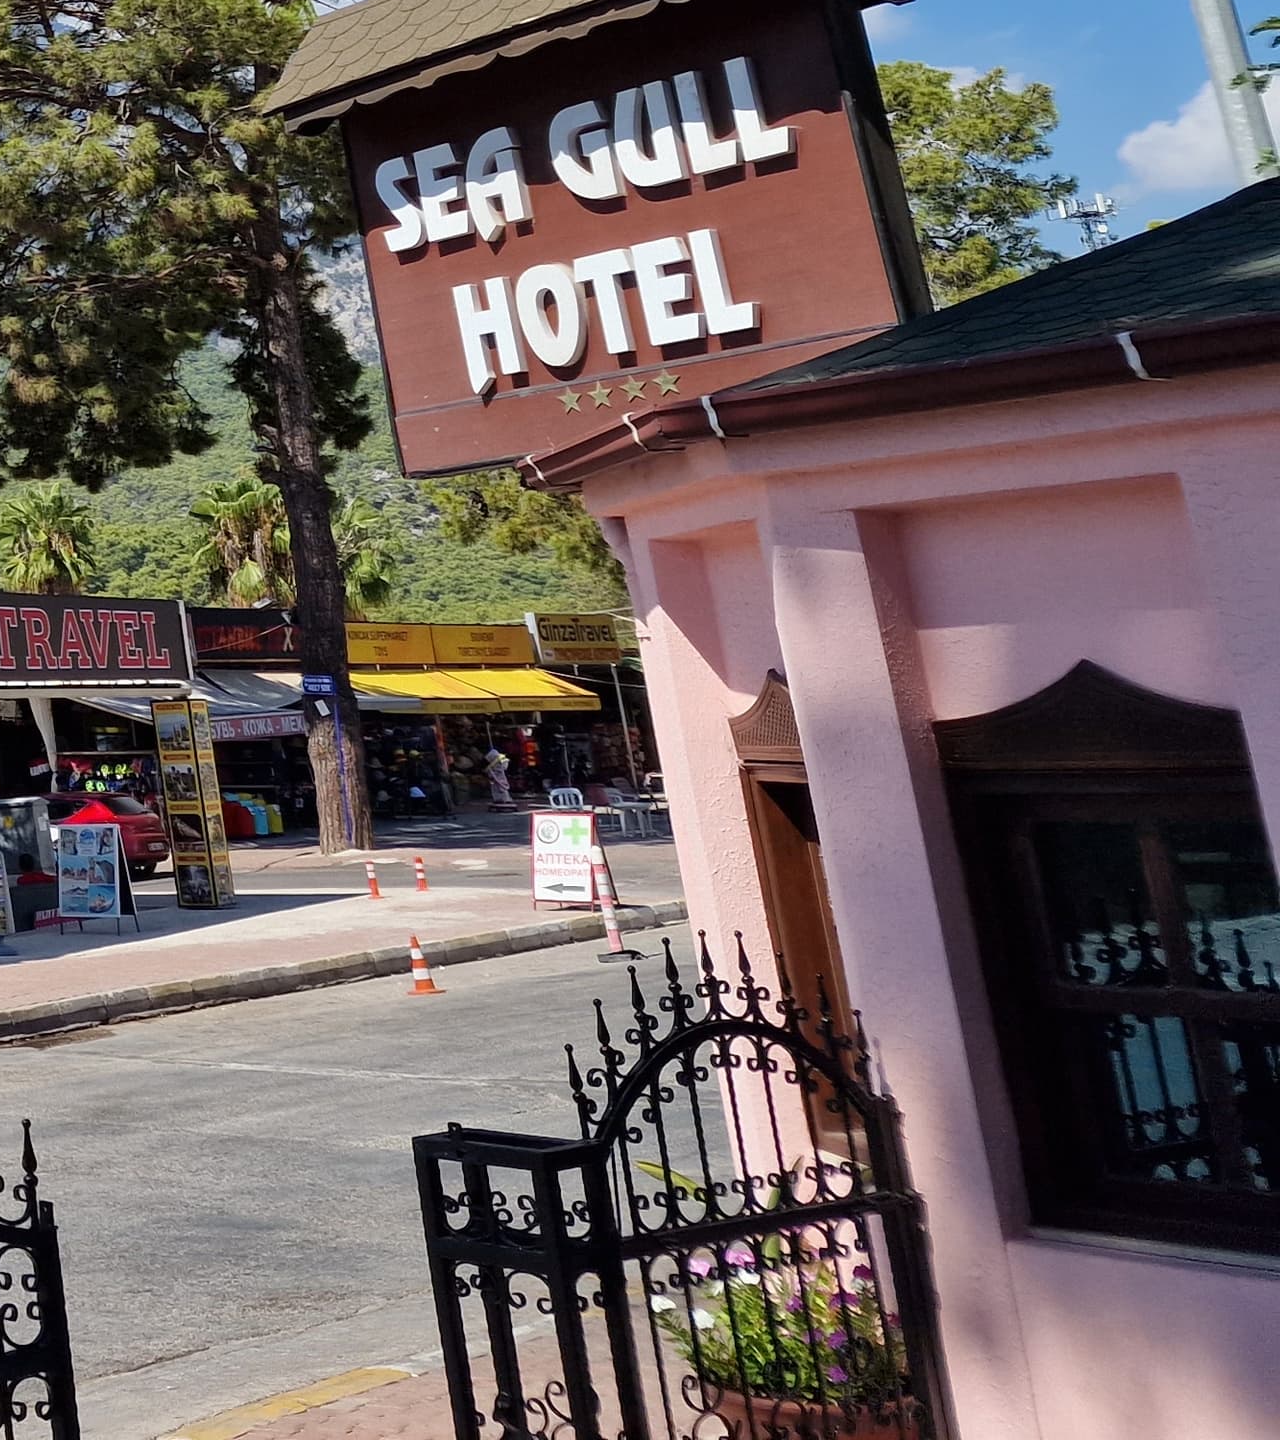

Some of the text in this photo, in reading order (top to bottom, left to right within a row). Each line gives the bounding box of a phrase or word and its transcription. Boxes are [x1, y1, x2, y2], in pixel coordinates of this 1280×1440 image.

[374, 57, 795, 252] SEA GULL
[452, 229, 760, 396] HOTEL
[536, 853, 591, 865] АПТЕКА
